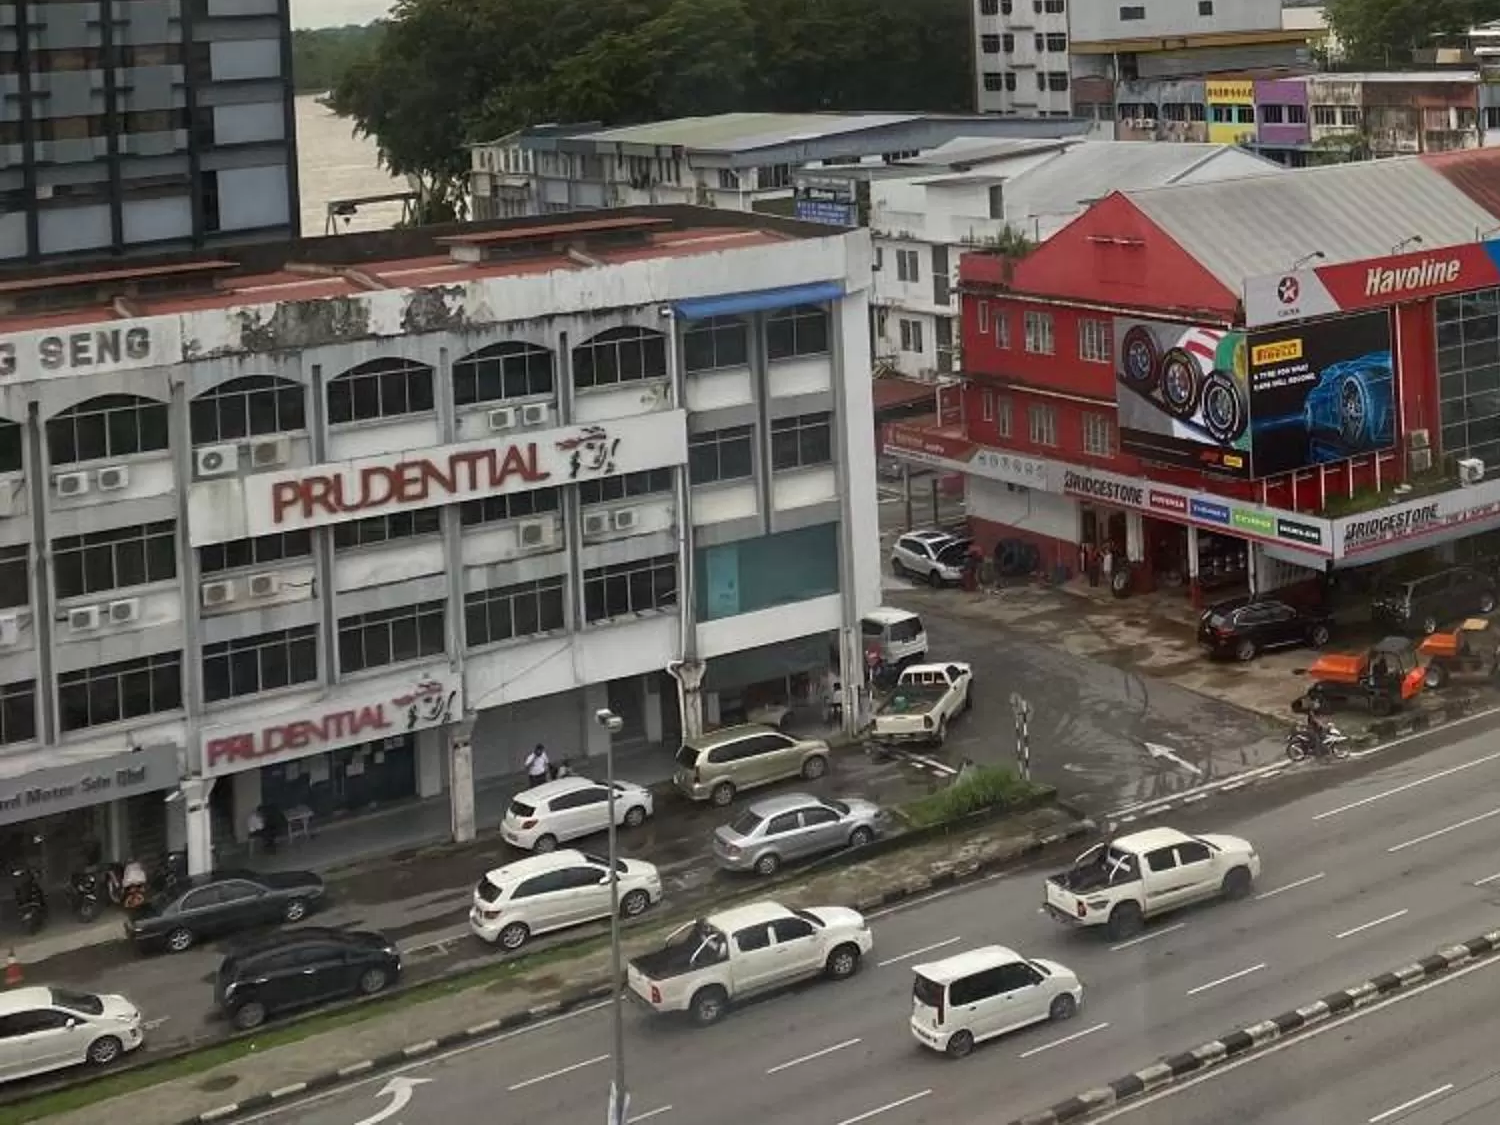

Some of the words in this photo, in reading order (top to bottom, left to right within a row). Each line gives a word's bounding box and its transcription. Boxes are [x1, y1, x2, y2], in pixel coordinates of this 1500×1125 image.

[1365, 259, 1460, 296] Havoline
[38, 327, 150, 370] SENG
[272, 442, 551, 524] PRUDENTIAL
[1064, 470, 1144, 505] BRIDGESTONE
[1345, 503, 1439, 540] BRIDGESTONE
[207, 705, 393, 768] PRUDENTIAL
